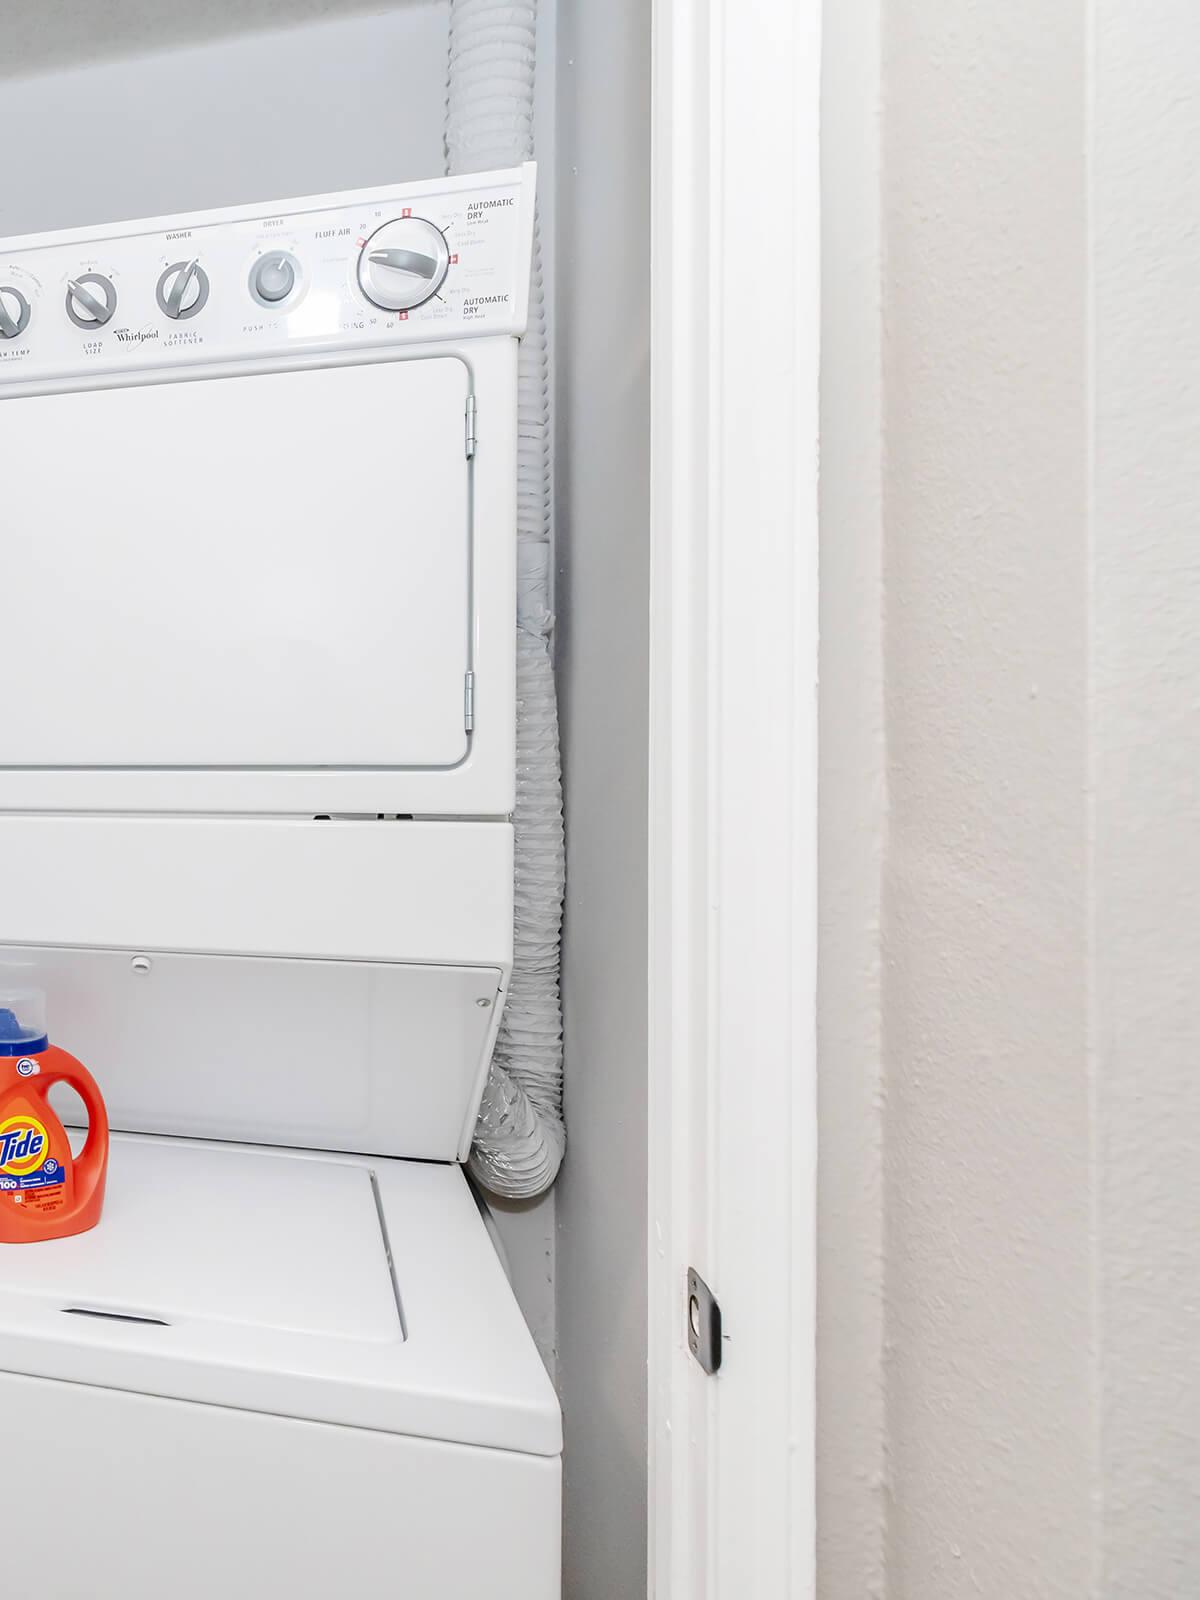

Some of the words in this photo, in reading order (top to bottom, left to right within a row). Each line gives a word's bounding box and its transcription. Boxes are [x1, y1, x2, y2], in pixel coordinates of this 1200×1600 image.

[467, 197, 514, 211] AUTOMATIC
[467, 211, 483, 220] DRY
[263, 219, 285, 228] DRYER
[166, 231, 192, 240] WASHER
[315, 229, 337, 239] FLUFF
[338, 227, 351, 236] AIR
[463, 294, 509, 306] AUTOMATIC
[463, 306, 479, 315] DRY
[243, 324, 264, 332] PUSH
[117, 330, 159, 342] Whirlpool
[168, 331, 198, 340] FABRIC
[82, 341, 103, 349] LOAD
[163, 337, 203, 347] SOFTENER
[11, 349, 31, 357] TEMP
[84, 347, 102, 355] SIZE
[0, 1180, 18, 1190] 100
